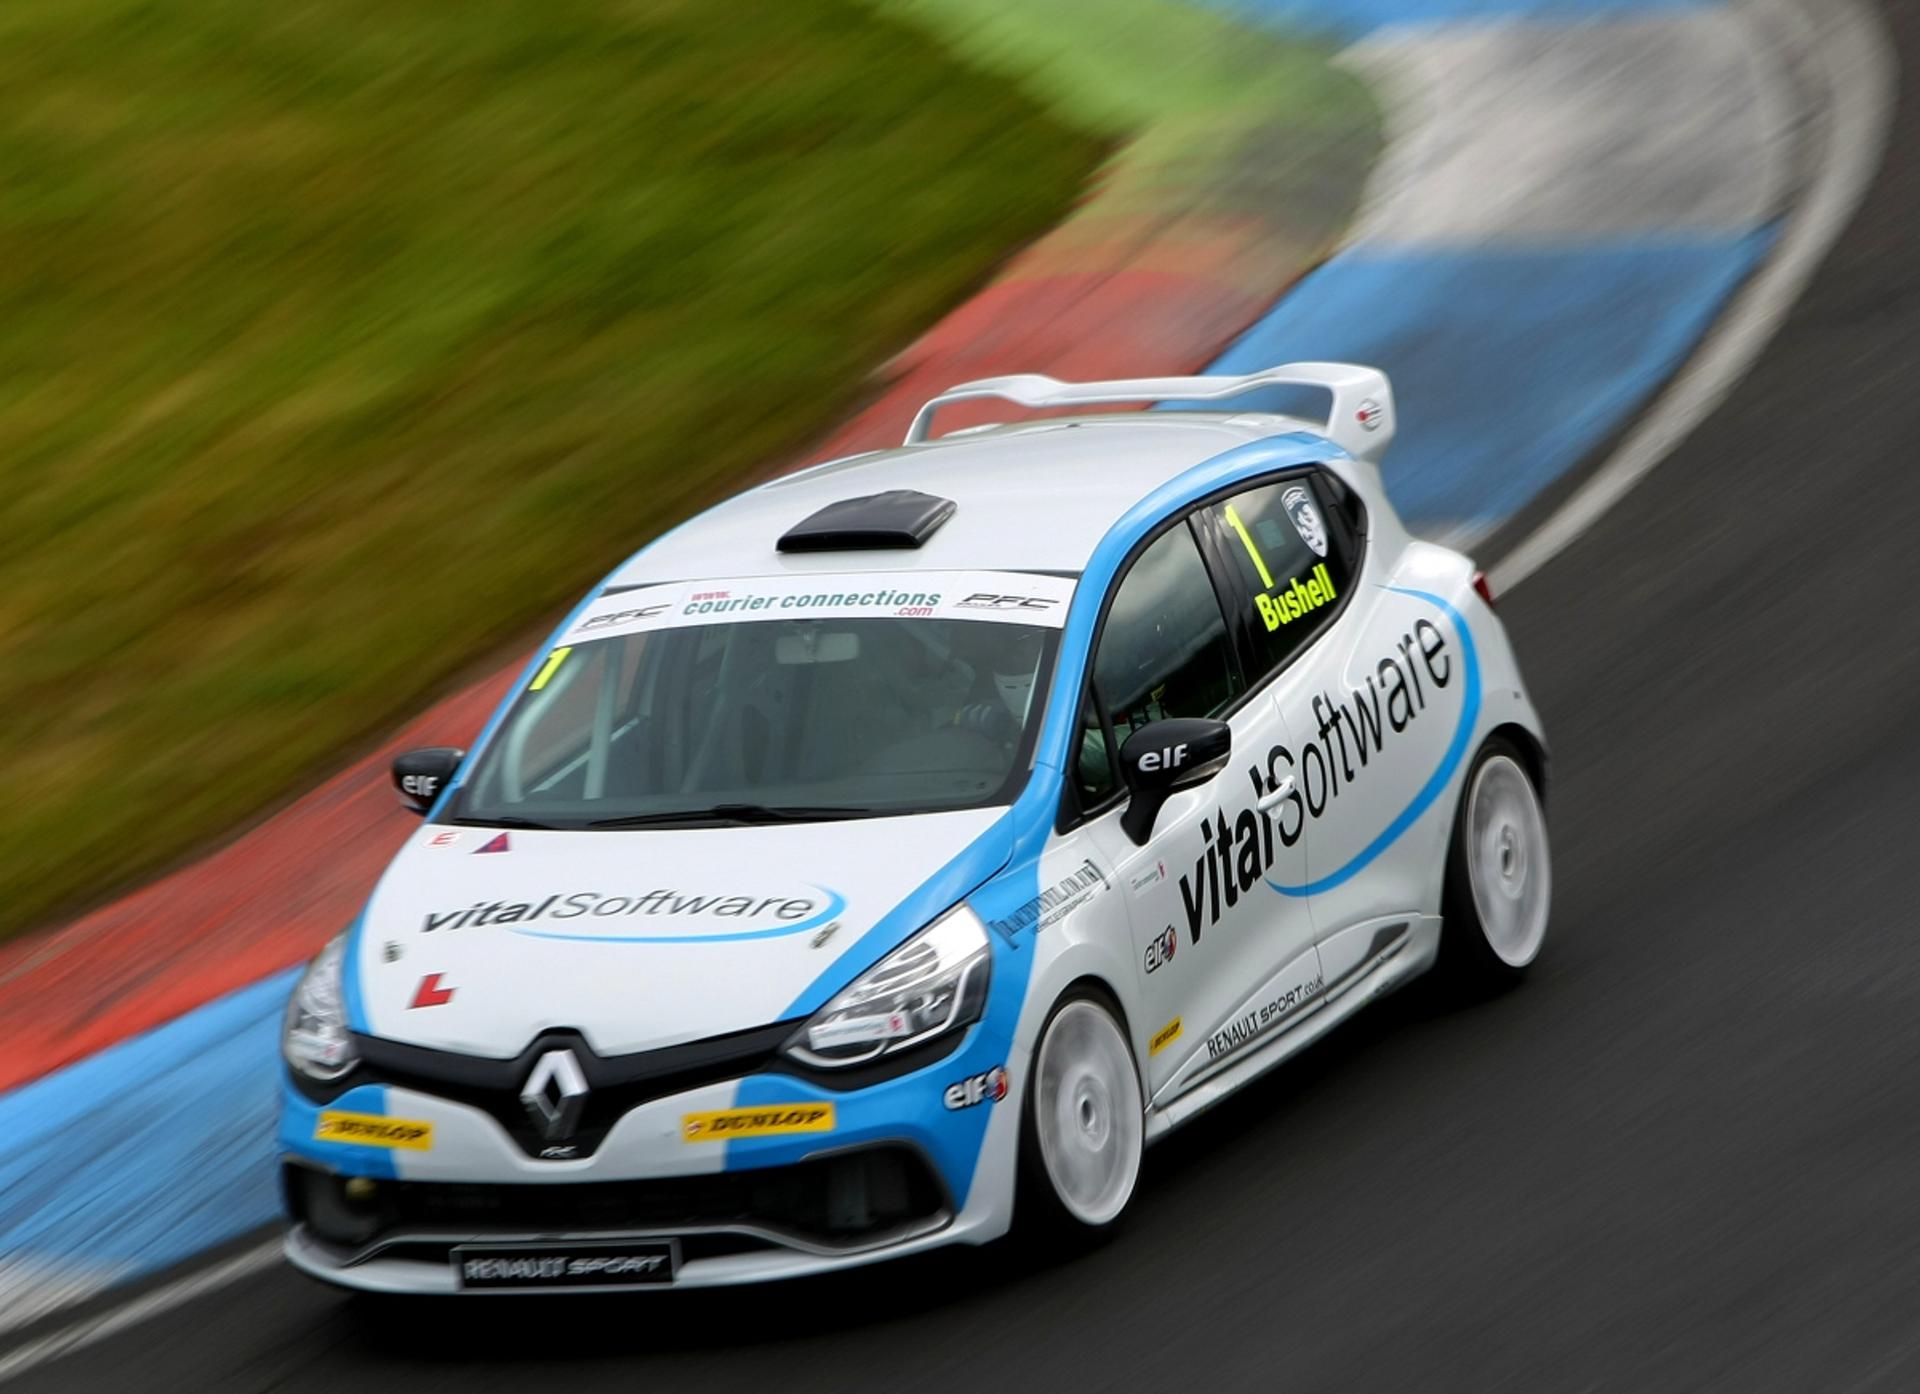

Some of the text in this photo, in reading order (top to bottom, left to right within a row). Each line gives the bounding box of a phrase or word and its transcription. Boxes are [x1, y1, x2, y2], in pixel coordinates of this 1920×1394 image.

[1225, 504, 1274, 589] 1
[683, 590, 942, 615] courier connections
[1255, 563, 1336, 632] Bushell
[529, 647, 572, 691] 1
[1138, 744, 1188, 772] elf
[402, 775, 440, 796] elf
[1144, 931, 1166, 973] elf
[1206, 1010, 1259, 1058] RENAULT
[944, 1074, 988, 1110] elf
[709, 1109, 826, 1132] DUNLOP
[566, 1254, 668, 1276] SPORT
